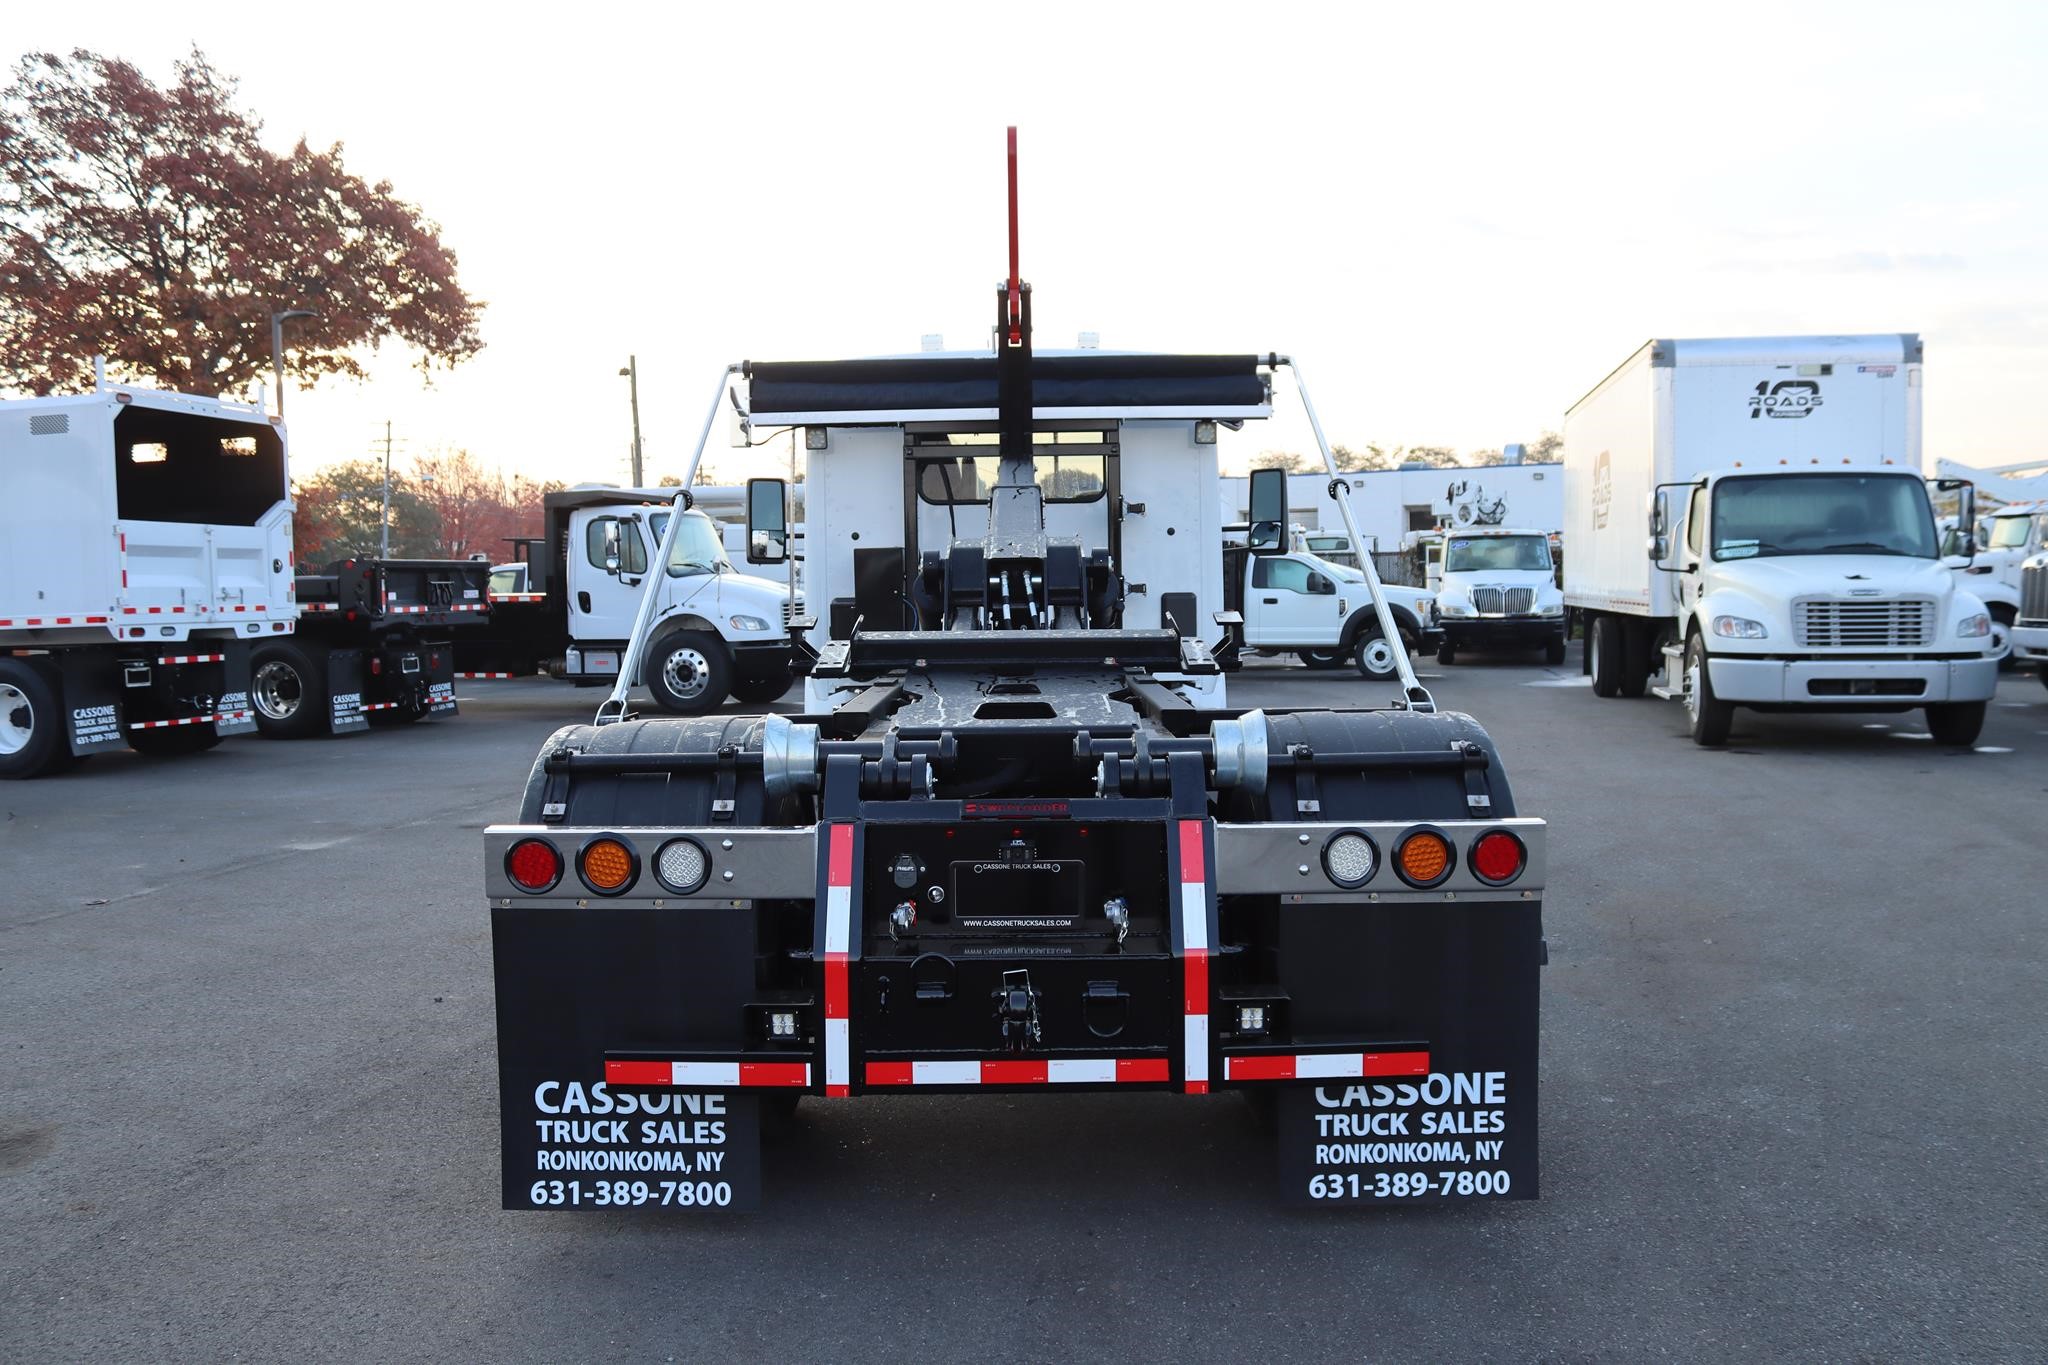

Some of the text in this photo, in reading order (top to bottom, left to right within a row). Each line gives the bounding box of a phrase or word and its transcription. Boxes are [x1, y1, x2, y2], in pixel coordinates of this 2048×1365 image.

[1748, 396, 1824, 407] ROADS
[1751, 380, 1820, 419] 10
[219, 692, 247, 703] ASSONE
[73, 705, 116, 719] CASSONE
[74, 716, 116, 727] TRUCK SALES
[979, 803, 1068, 813] SWAPLOADER
[534, 1081, 726, 1115] CASSONE
[1315, 1071, 1506, 1108] CASSONE
[536, 1120, 726, 1144] TRUCK SALES
[1315, 1110, 1506, 1137] TRUCK SALES
[537, 1150, 725, 1175] RONKONKOMA, NY
[1315, 1141, 1504, 1165] RONKONKOMA, NY
[530, 1180, 732, 1207] 631-389-7800
[1308, 1170, 1511, 1199] 631-389-7800
